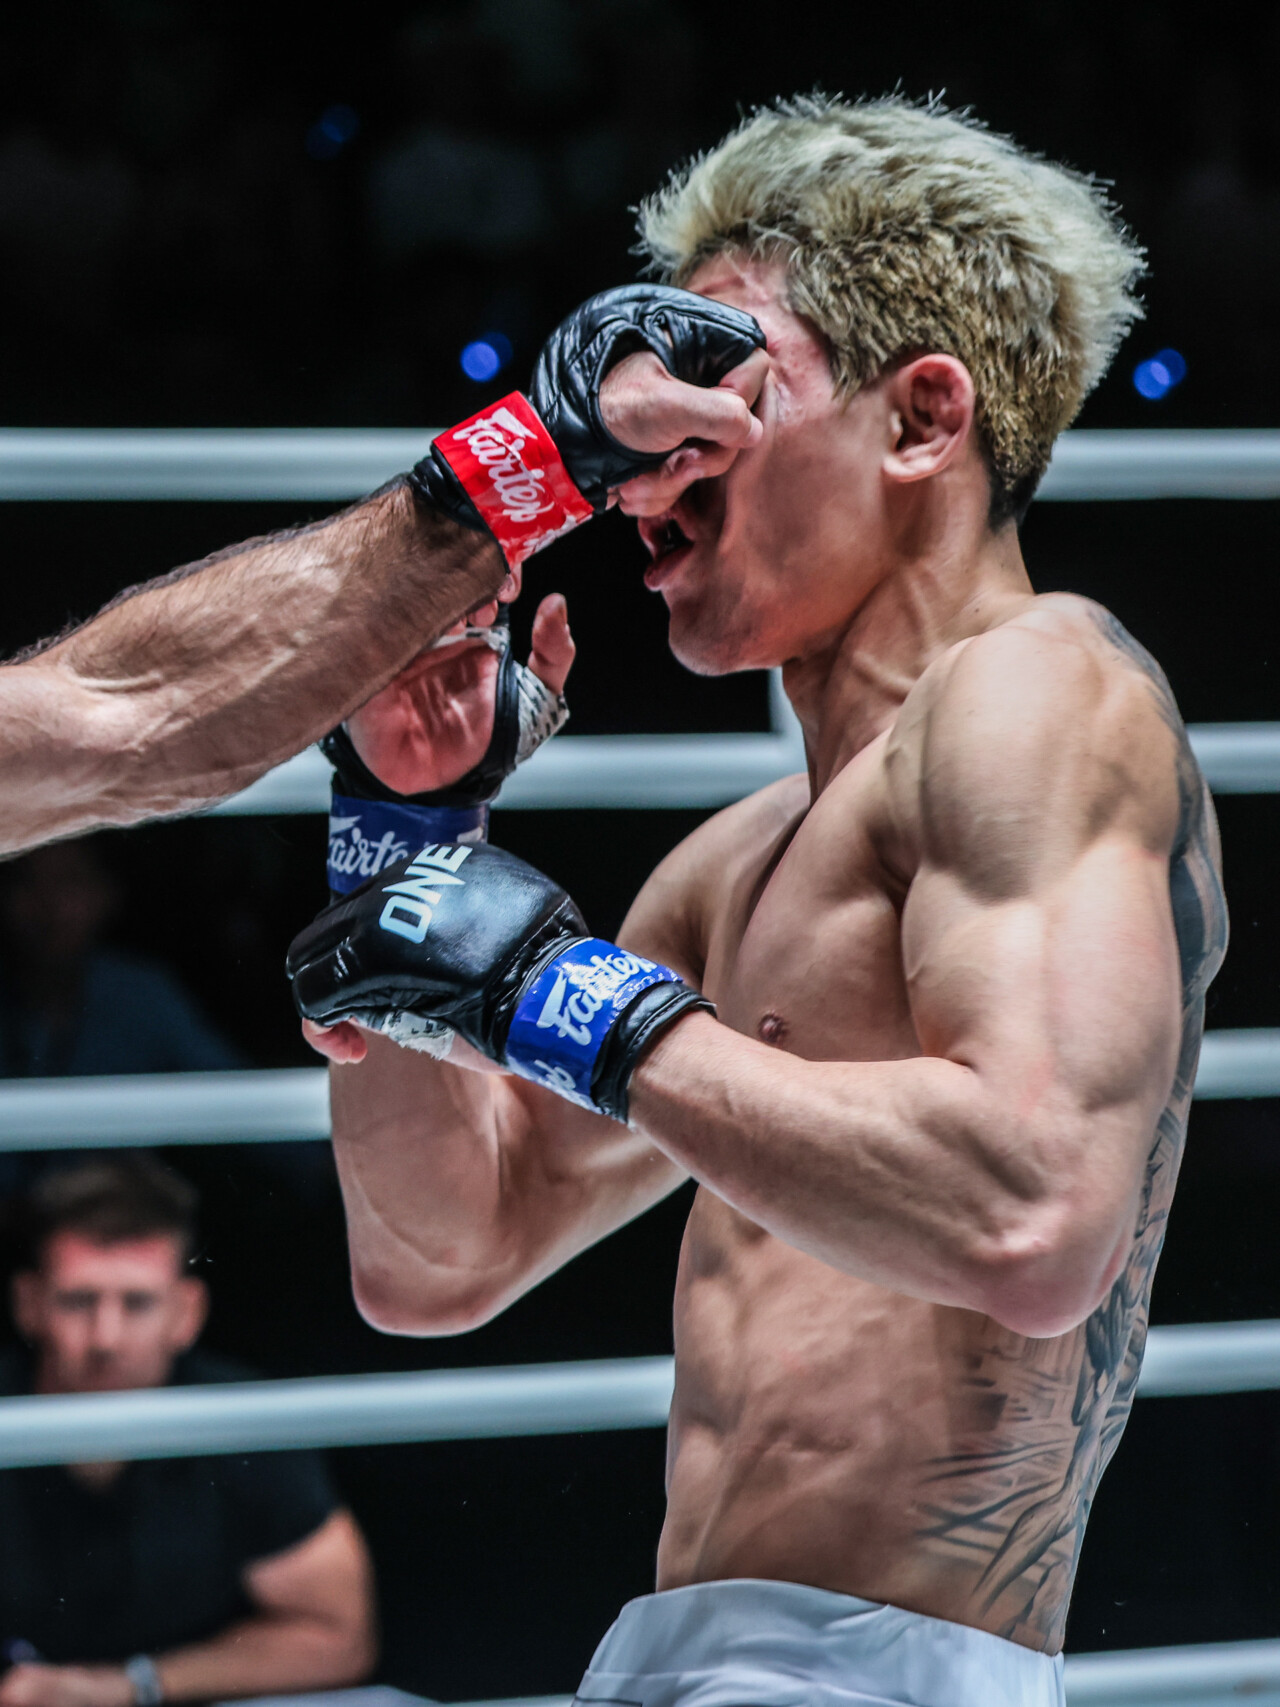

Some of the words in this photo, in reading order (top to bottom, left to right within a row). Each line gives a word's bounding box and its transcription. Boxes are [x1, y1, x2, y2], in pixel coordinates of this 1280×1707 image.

[452, 406, 555, 523] Fairtex
[328, 814, 410, 877] airte
[379, 843, 473, 944] ONE
